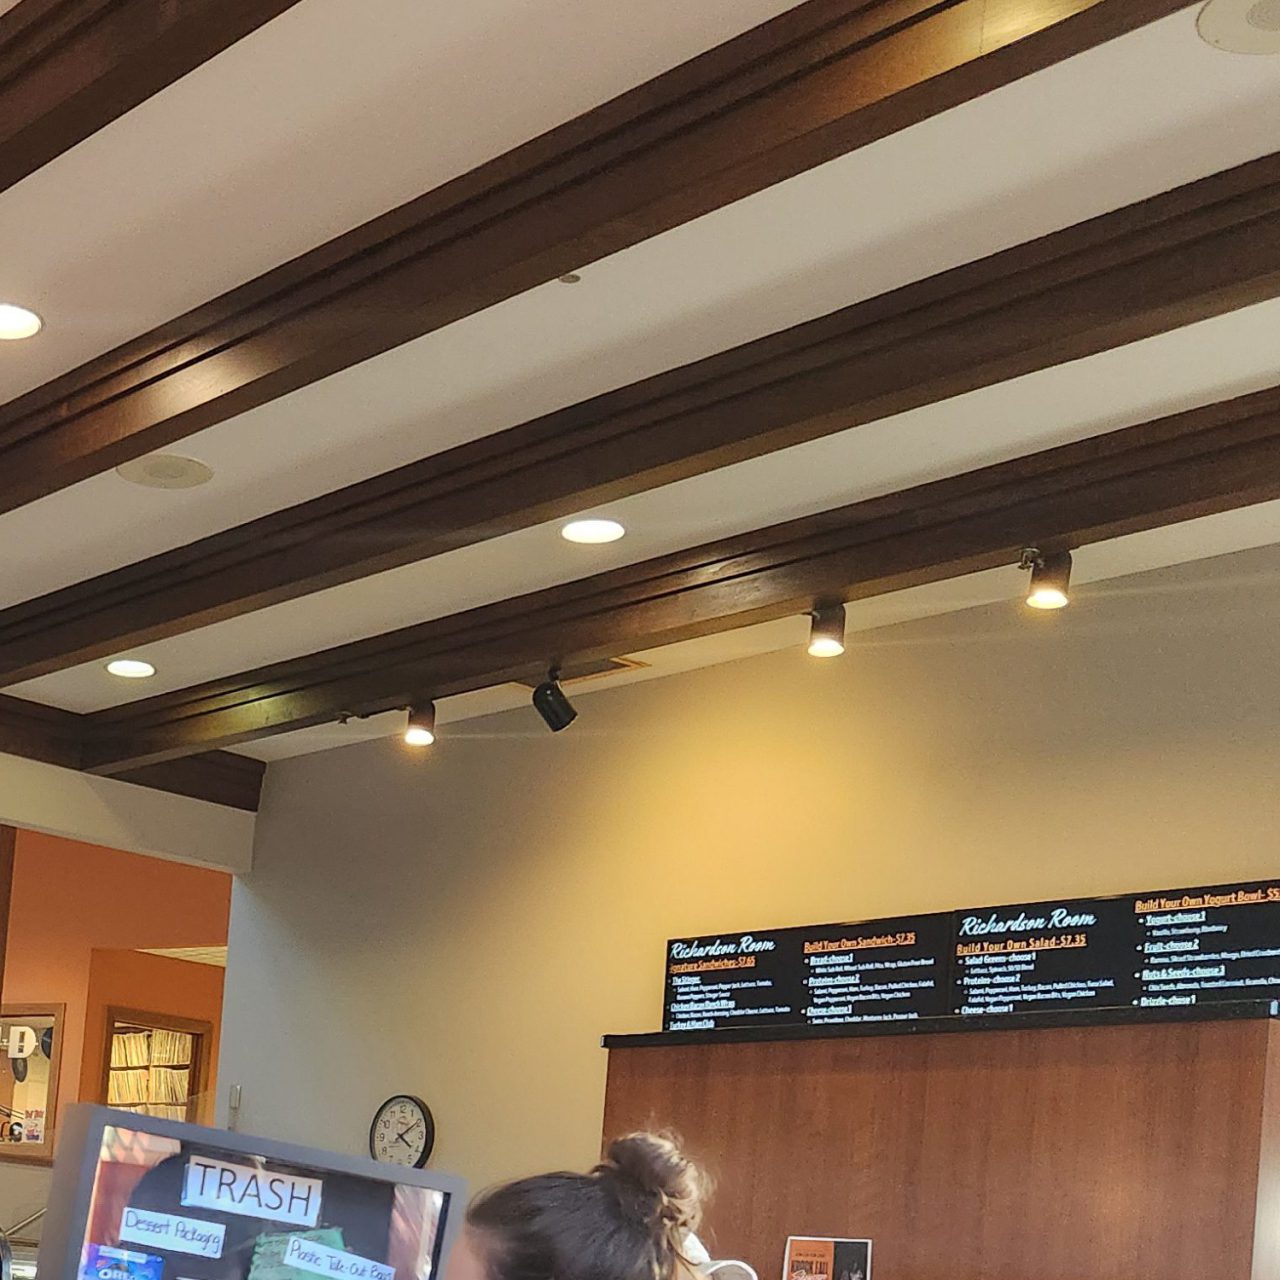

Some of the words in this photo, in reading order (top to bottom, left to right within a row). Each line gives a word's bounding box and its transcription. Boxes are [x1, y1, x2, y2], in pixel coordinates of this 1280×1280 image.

[959, 913, 1047, 936] Richardson
[1048, 908, 1097, 929] Room
[671, 939, 736, 959] Richardson
[737, 935, 776, 954] Room
[956, 943, 981, 956] Build
[983, 941, 1004, 954] Your
[1007, 940, 1027, 952] Own
[194, 1163, 313, 1216] TRASH
